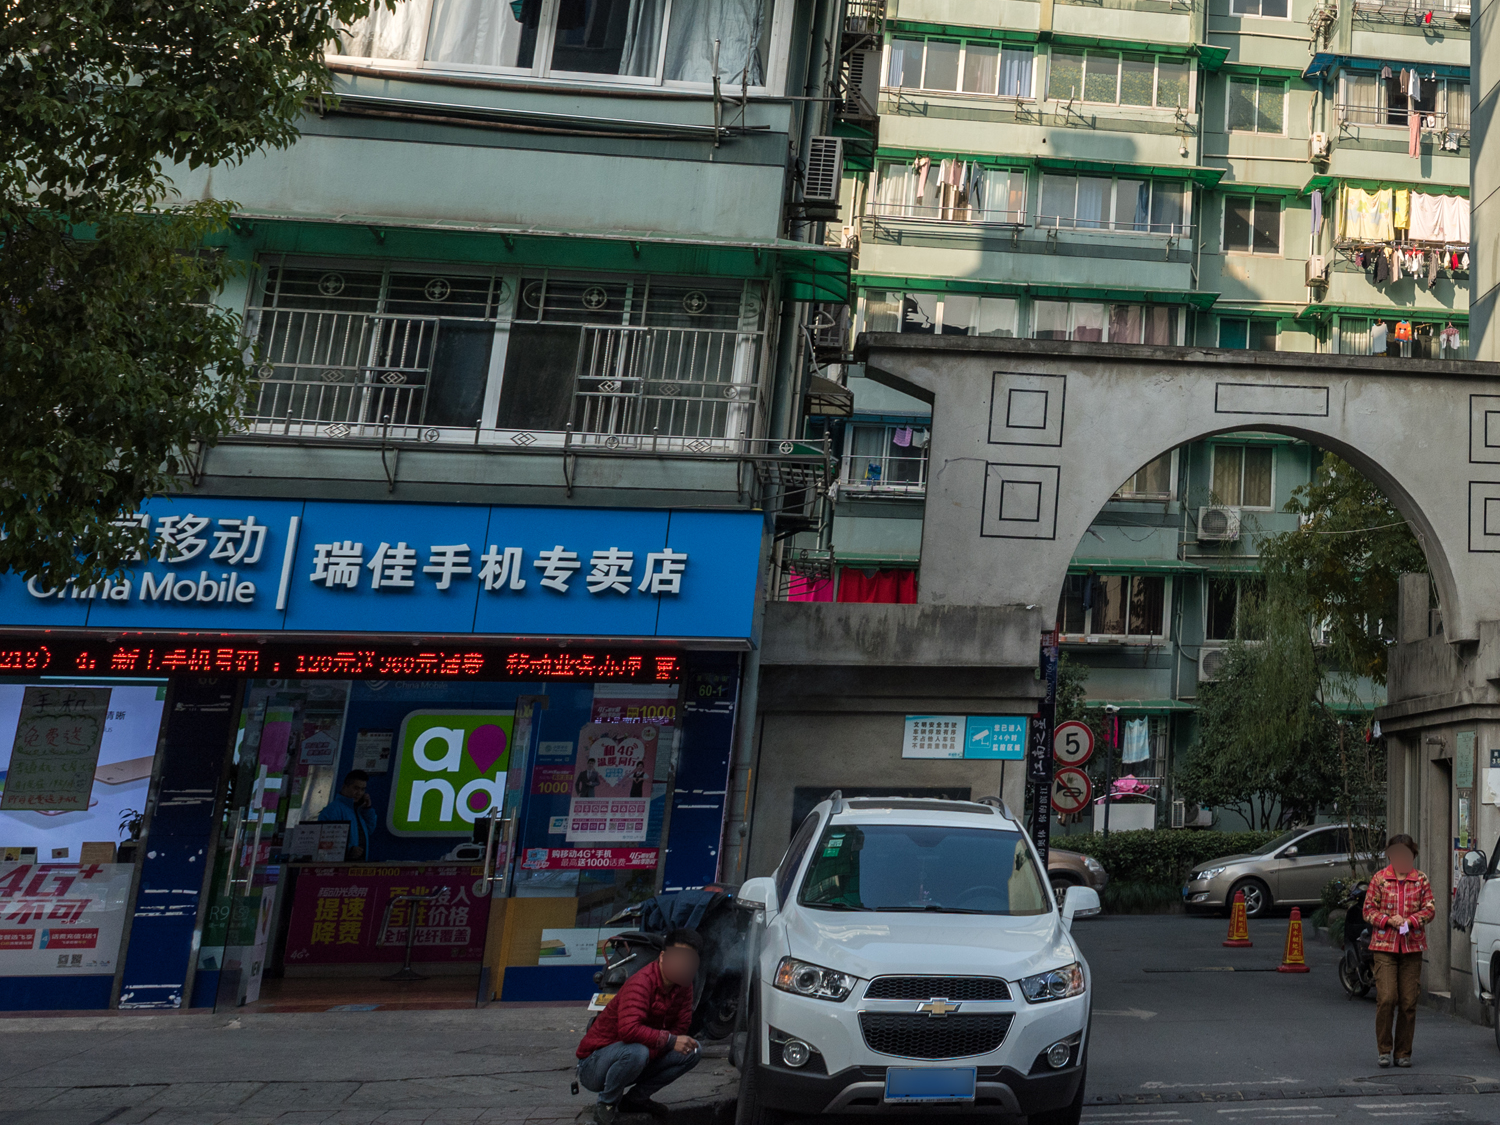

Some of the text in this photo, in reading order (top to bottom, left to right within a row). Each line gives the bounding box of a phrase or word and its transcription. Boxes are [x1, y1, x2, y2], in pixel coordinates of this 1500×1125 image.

[309, 540, 688, 594] 瑞佳手机专卖店
[138, 571, 256, 603] Mobile
[698, 685, 723, 696] 60-1
[33, 693, 89, 713] 手机
[638, 705, 676, 719] 1000
[993, 724, 1022, 732] 您已进入
[993, 734, 1018, 742] 24小时
[992, 743, 1021, 752] 监控区域
[1032, 717, 1047, 776] 江南之星
[1065, 732, 1080, 755] 5
[537, 781, 569, 794] 1000
[560, 858, 626, 868] 最高送1000话费
[0, 899, 92, 924] 不可
[314, 897, 367, 921] 提速
[310, 921, 361, 945] 降费
